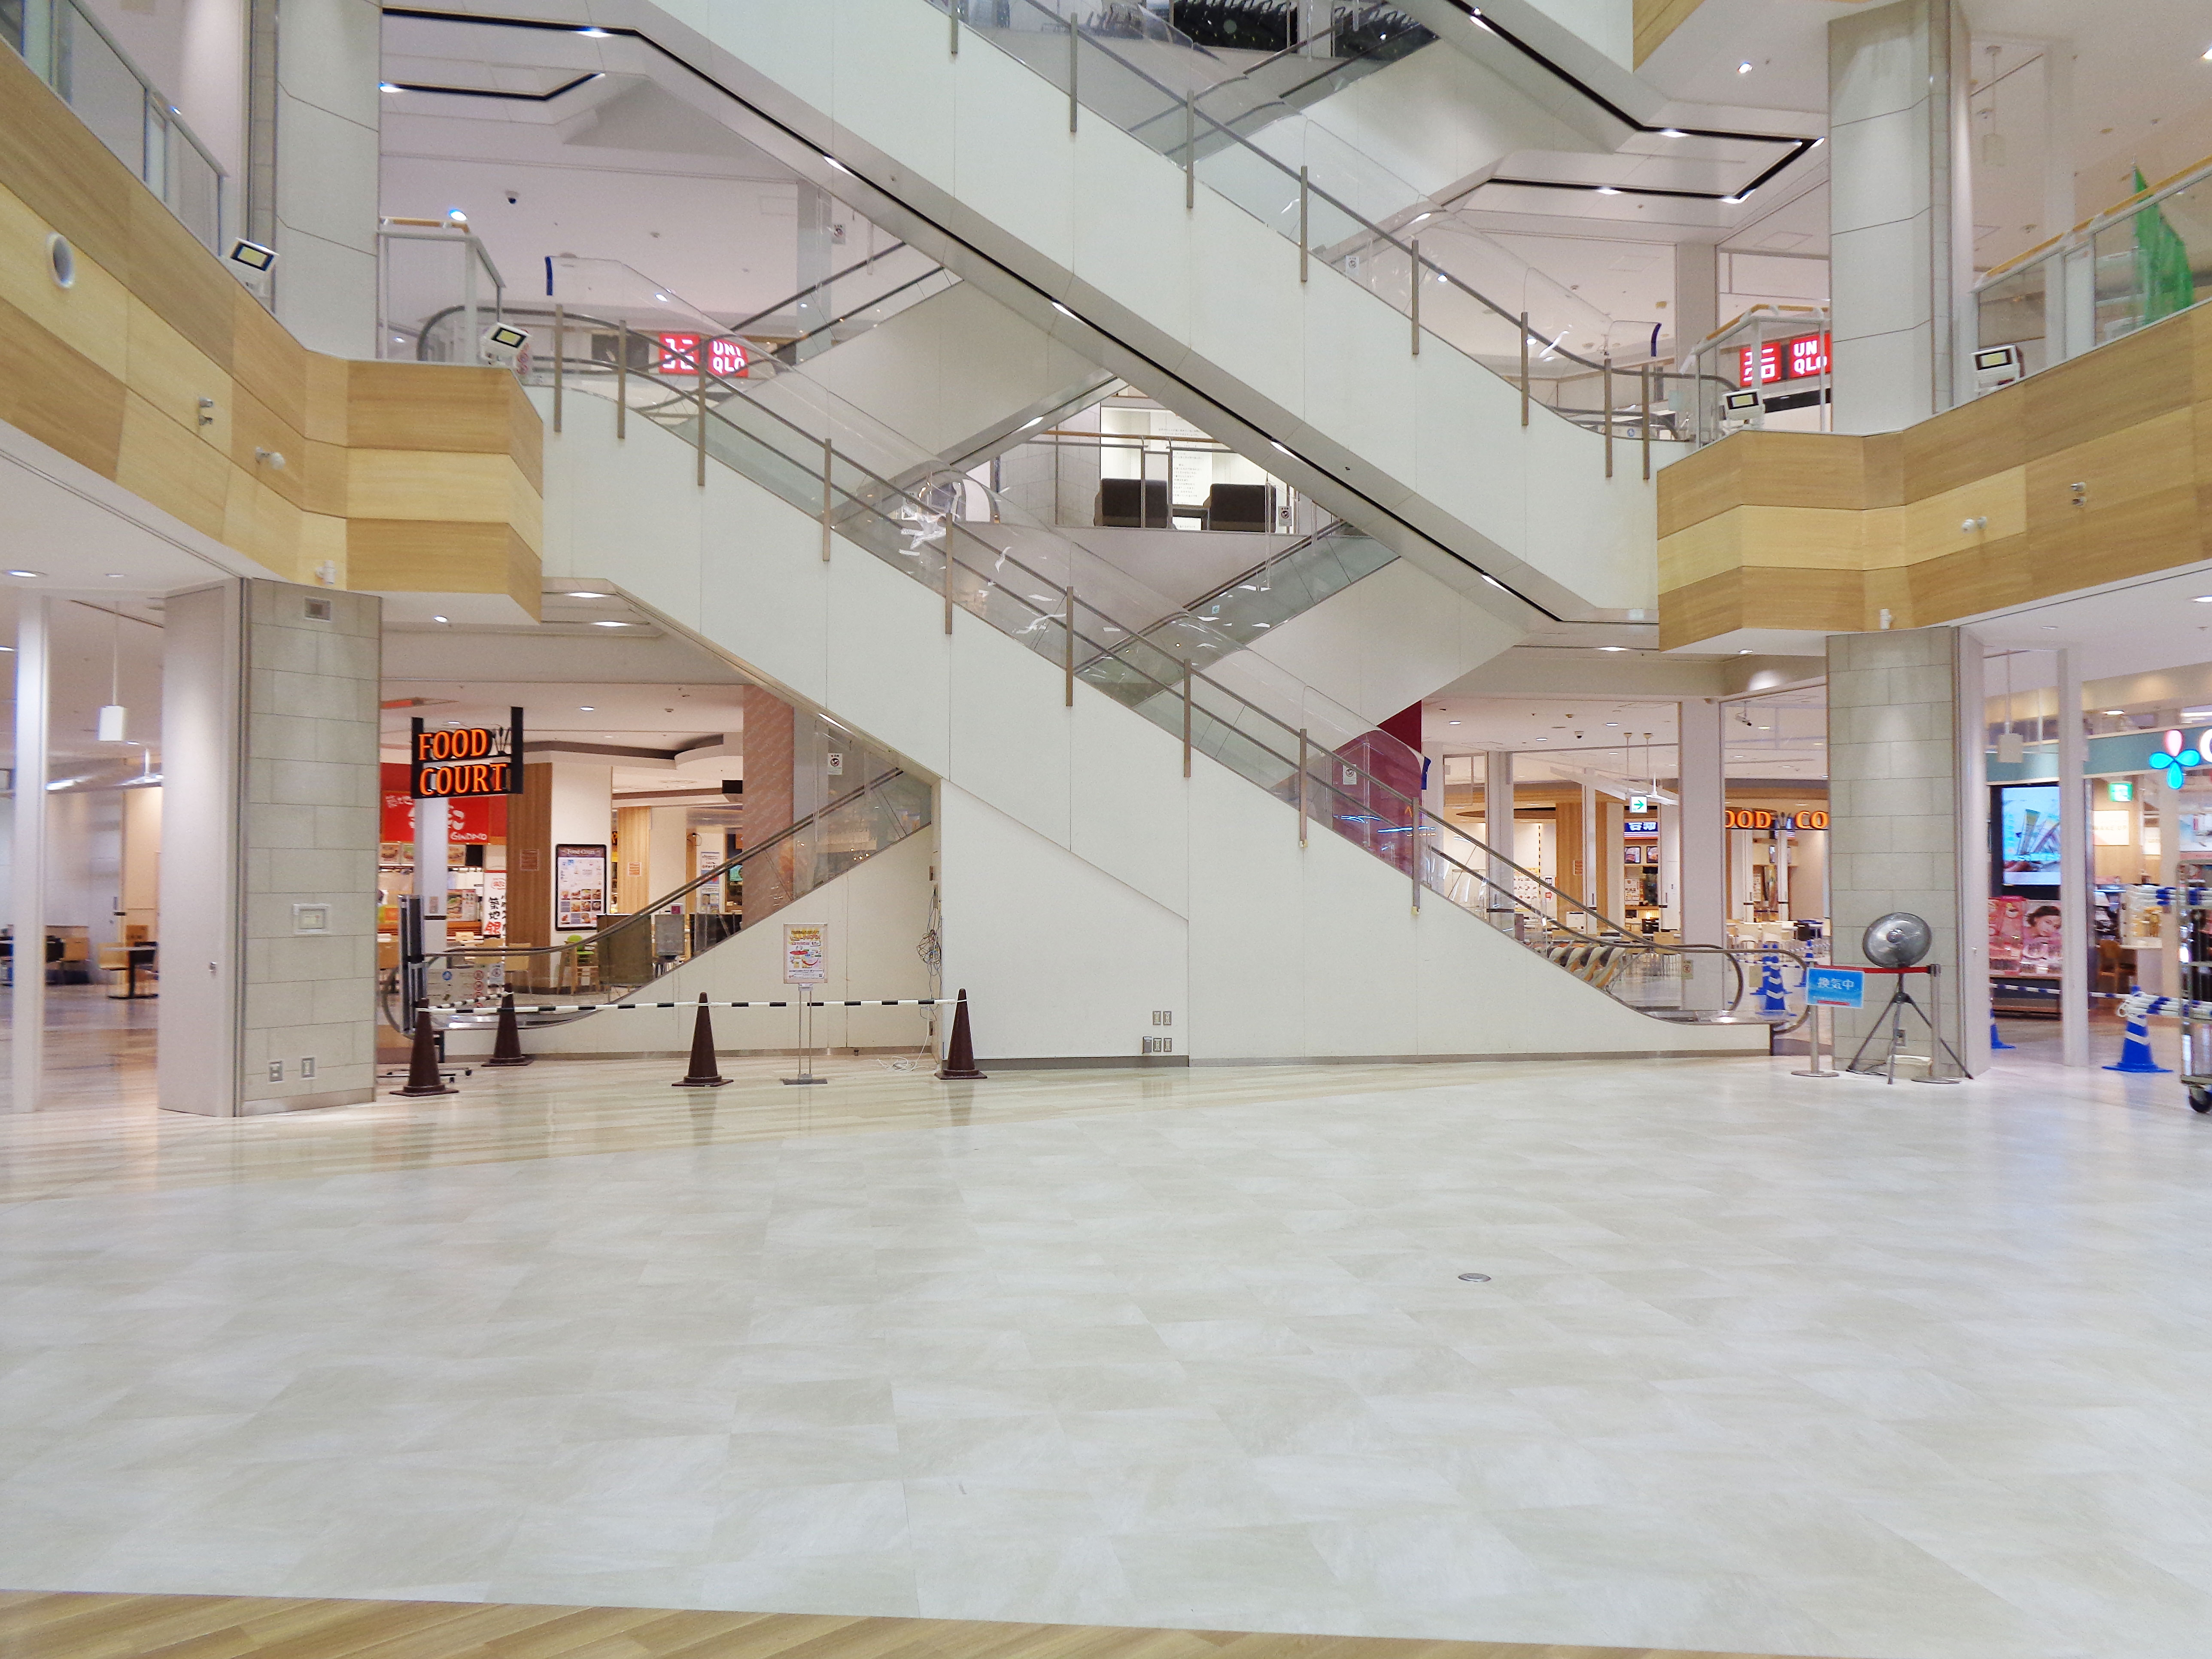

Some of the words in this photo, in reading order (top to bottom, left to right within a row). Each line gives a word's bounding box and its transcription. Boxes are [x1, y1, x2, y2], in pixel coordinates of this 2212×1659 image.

[713, 340, 741, 356] UNI
[1793, 340, 1819, 357] UN
[713, 357, 745, 374] QLO
[1793, 356, 1827, 375] QLO
[418, 728, 489, 761] FOOD
[419, 763, 508, 796] COURT
[1725, 809, 1772, 829] OOD
[1796, 810, 1829, 830] CO
